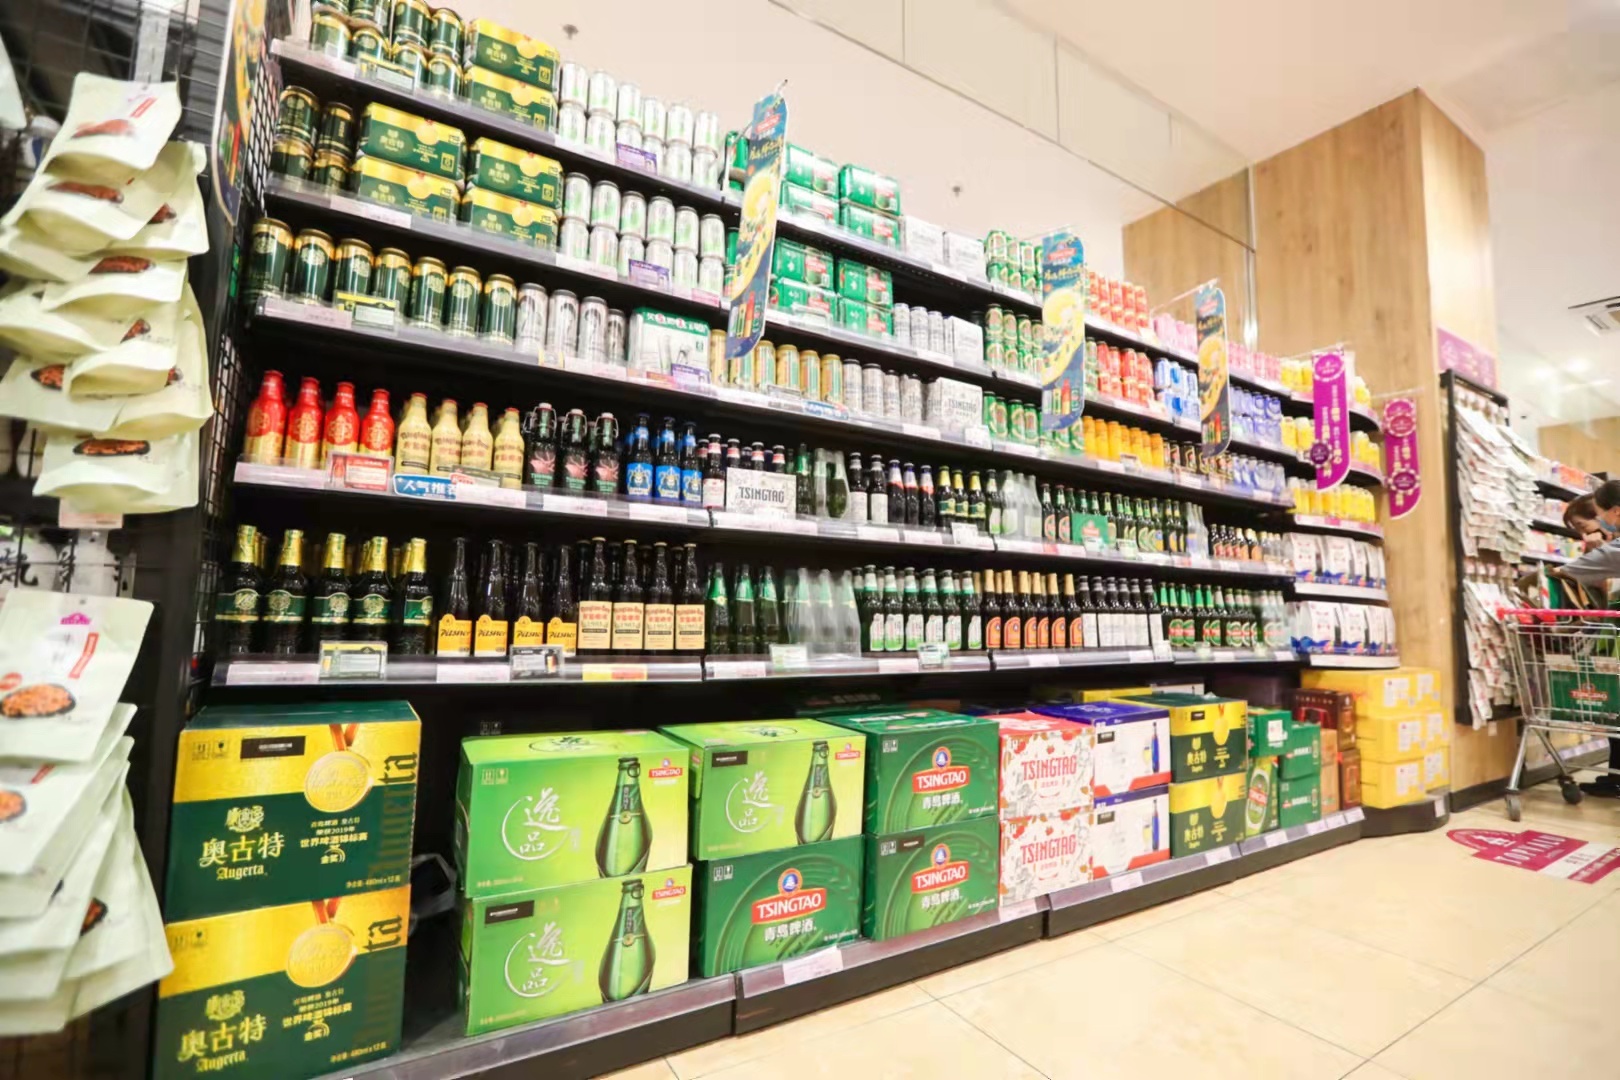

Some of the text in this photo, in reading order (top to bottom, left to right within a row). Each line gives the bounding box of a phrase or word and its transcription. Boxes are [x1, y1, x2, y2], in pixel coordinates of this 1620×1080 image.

[916, 770, 967, 789] TSINGTAO
[199, 832, 285, 868] 奥古特
[915, 865, 966, 888] TSINGTAO
[757, 893, 822, 919] TSINGTAO
[764, 917, 815, 942] 青岛啤酒
[177, 1013, 269, 1062] 奥古特
